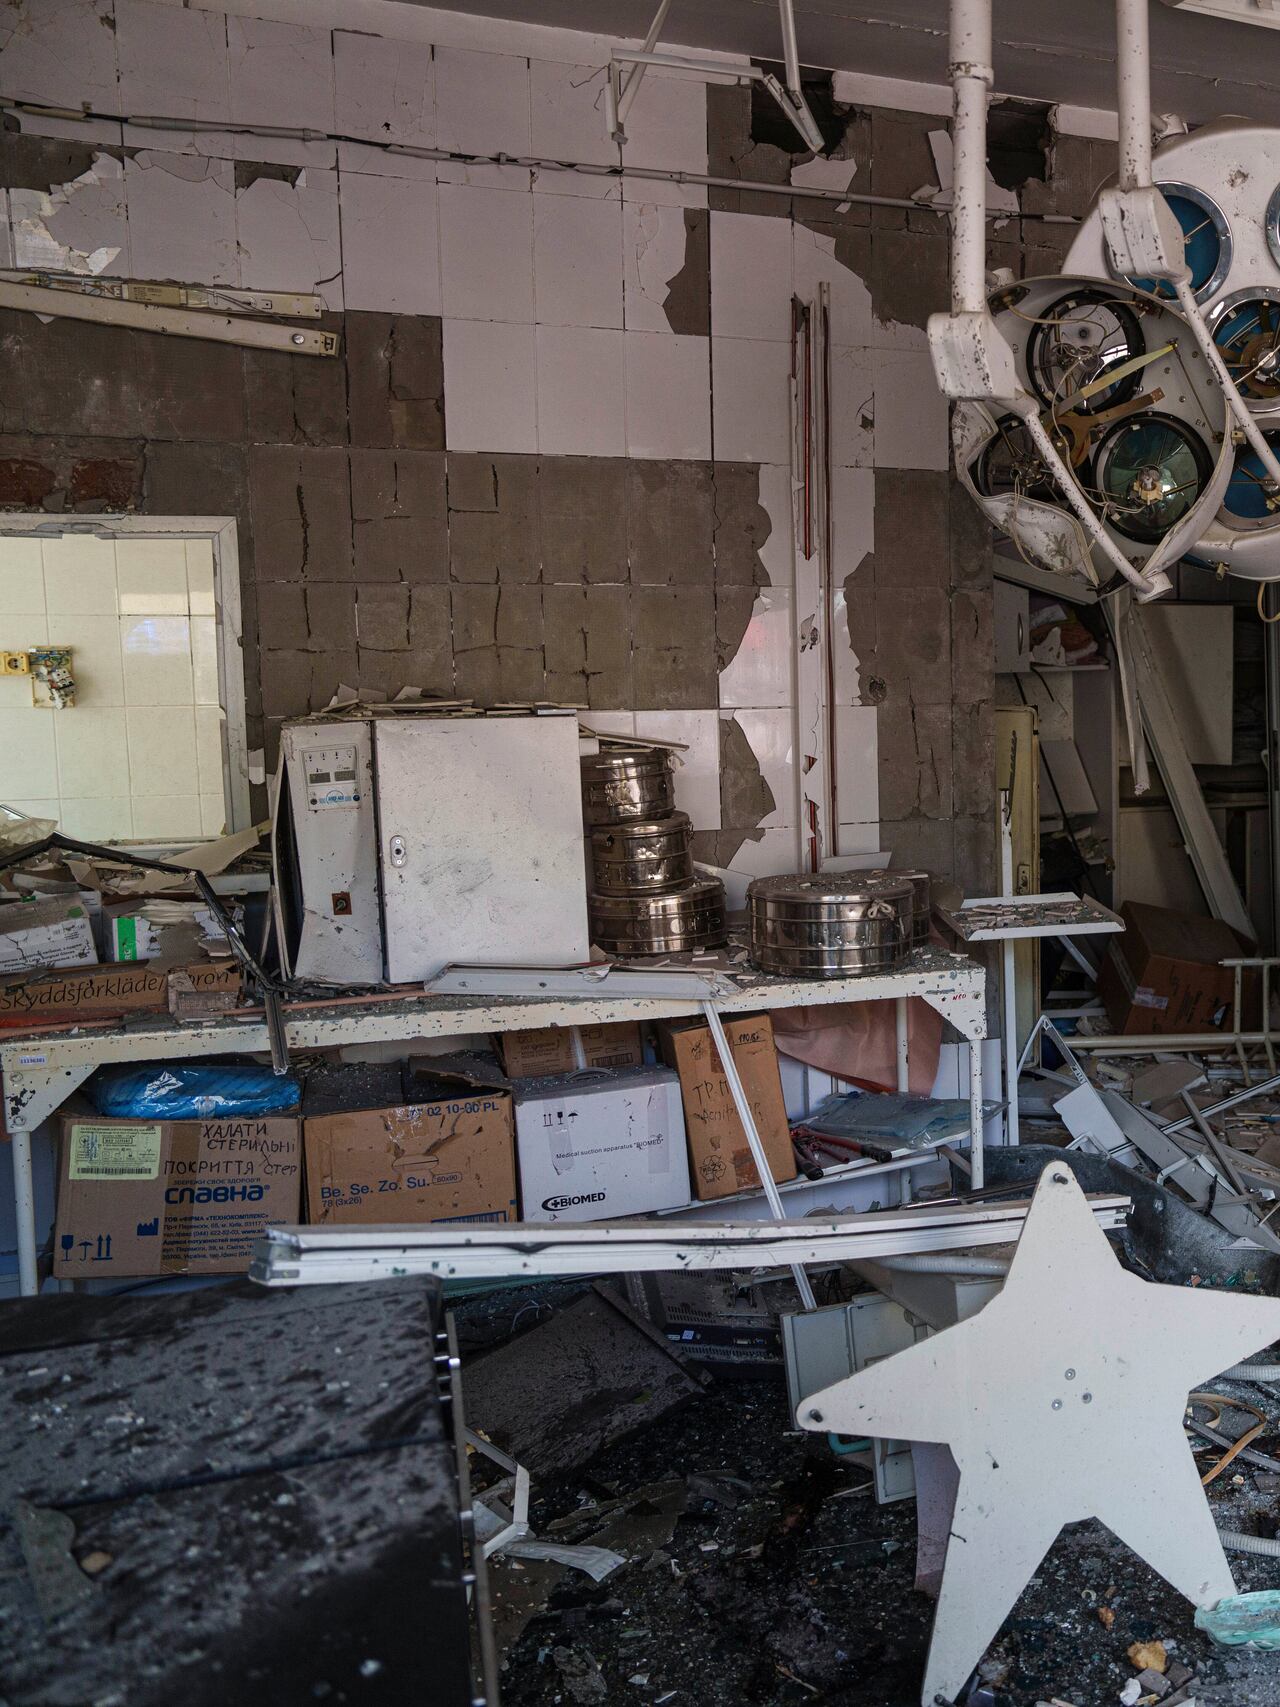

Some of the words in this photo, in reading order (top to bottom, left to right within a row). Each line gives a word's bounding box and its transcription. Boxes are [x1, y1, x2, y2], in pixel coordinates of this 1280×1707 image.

[483, 1101, 500, 1113] PL
[203, 1123, 267, 1139] ХАЛАТИ
[556, 1151, 580, 1160] Medical
[580, 1147, 603, 1156] suction
[603, 1144, 633, 1154] apparatus
[164, 1160, 254, 1176] ПОКРИТТЯ
[321, 1186, 345, 1199] Be.
[350, 1183, 374, 1196] Se.
[378, 1180, 402, 1193] Zo.
[407, 1176, 430, 1190] Su.
